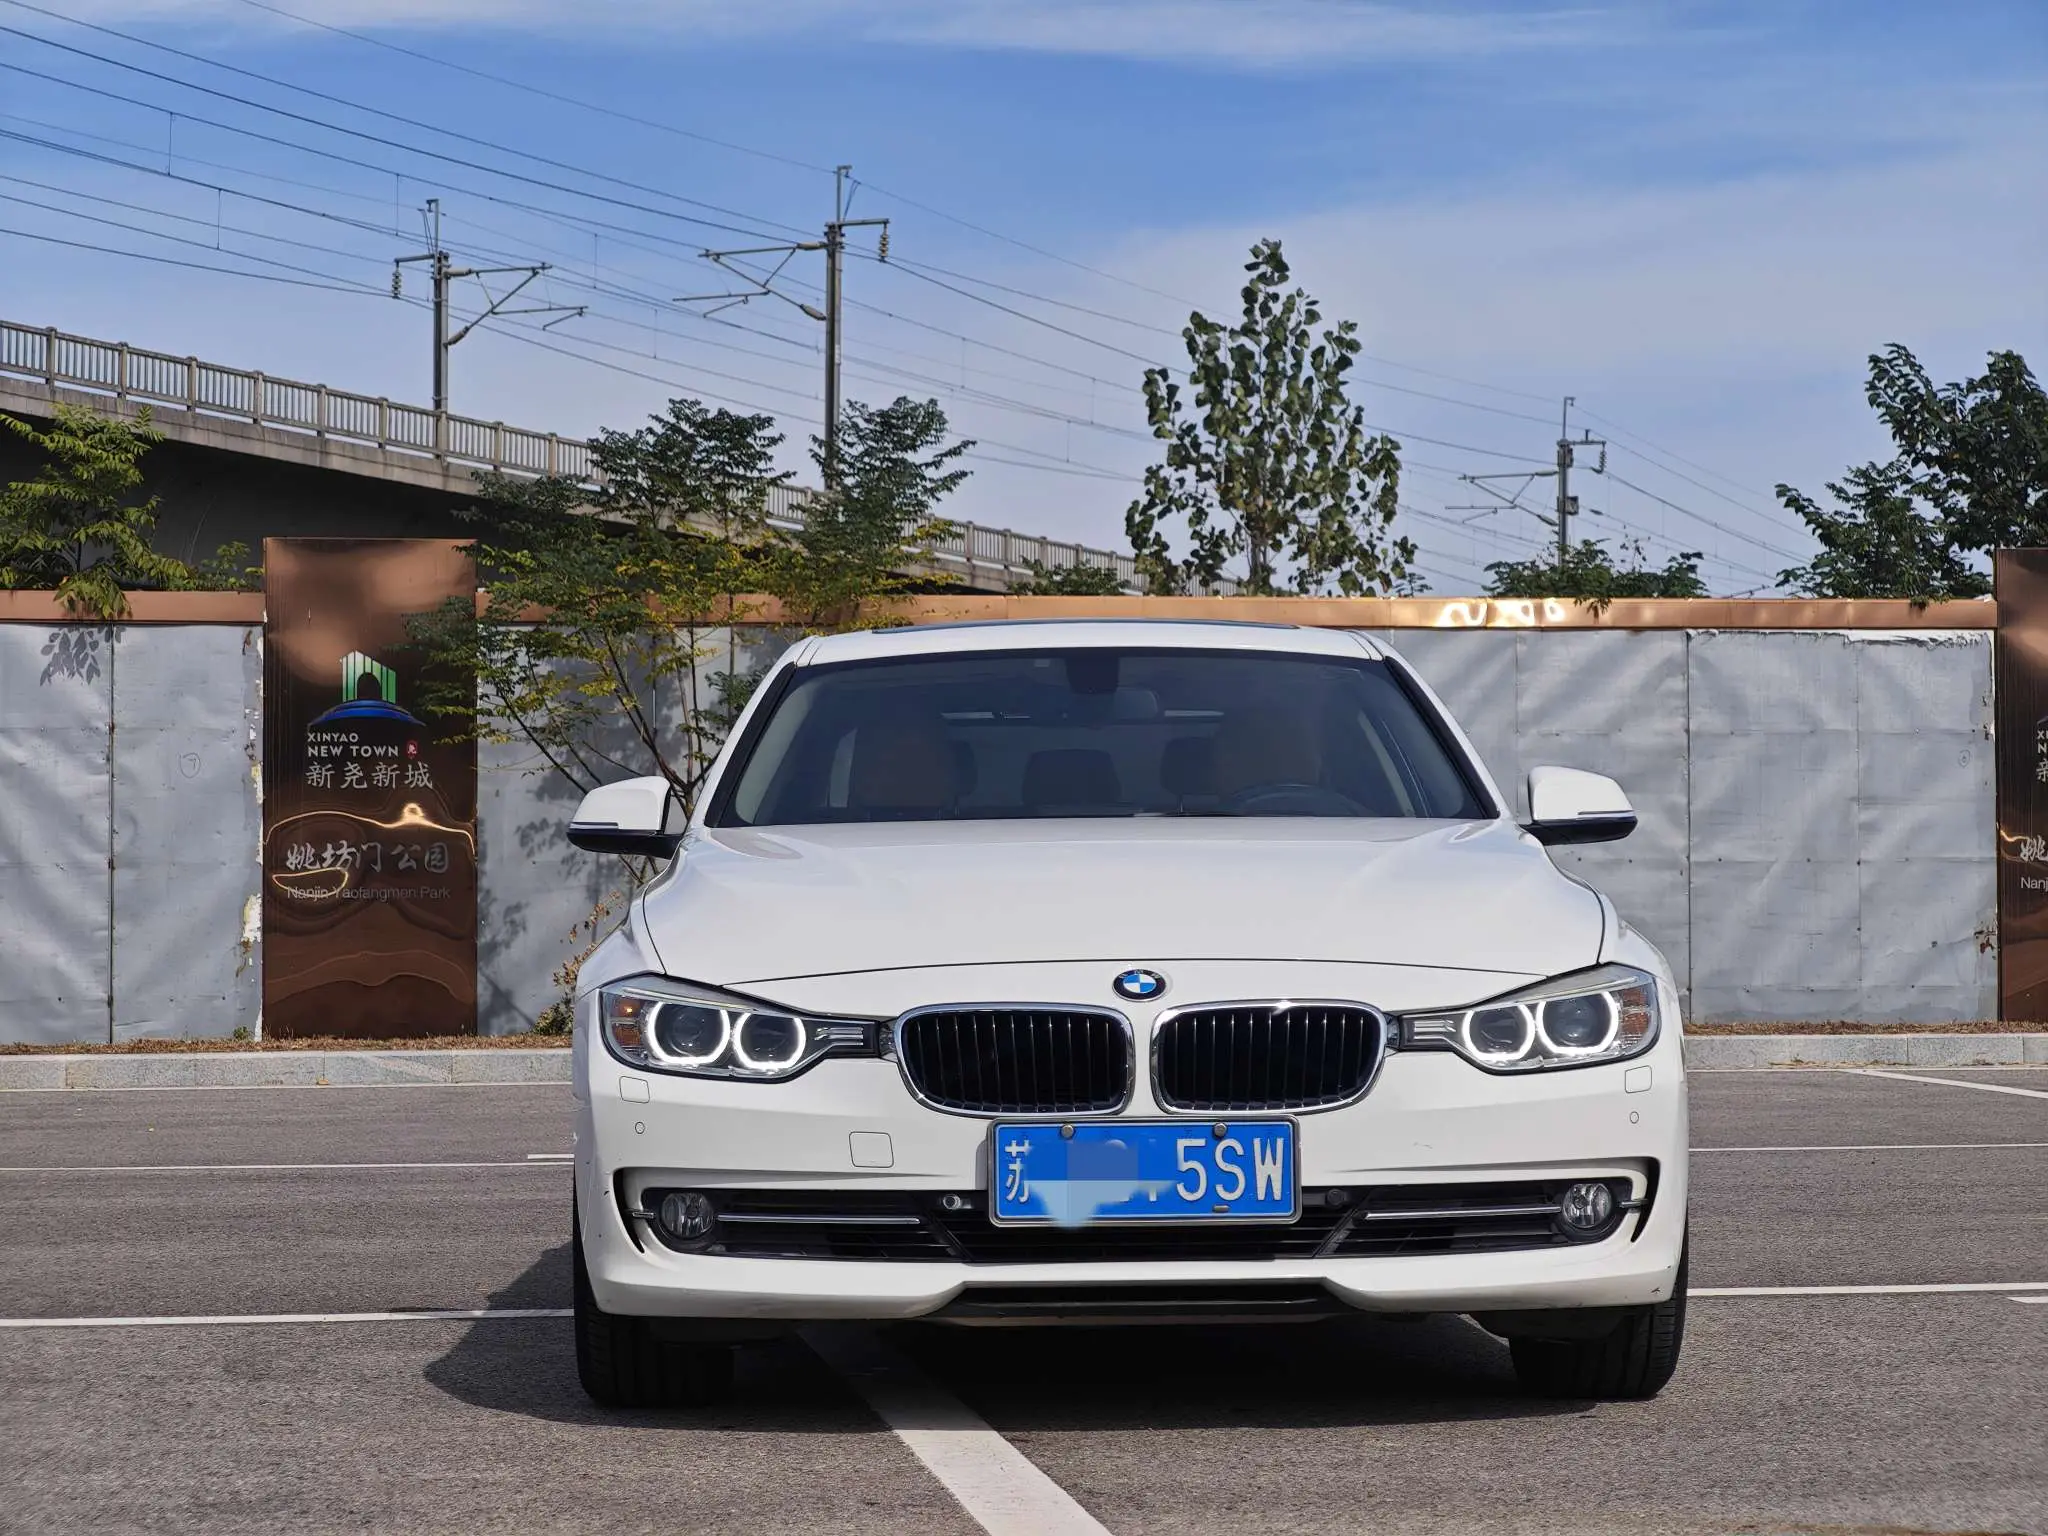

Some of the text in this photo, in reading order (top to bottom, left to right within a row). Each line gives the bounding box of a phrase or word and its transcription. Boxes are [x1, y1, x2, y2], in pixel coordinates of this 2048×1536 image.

[307, 732, 359, 742] XINYAO
[307, 745, 343, 757] NEW
[350, 745, 399, 757] TOWN
[305, 760, 433, 790] 新尧新城
[286, 839, 449, 873] 姚坊门公园
[420, 885, 451, 900] Park
